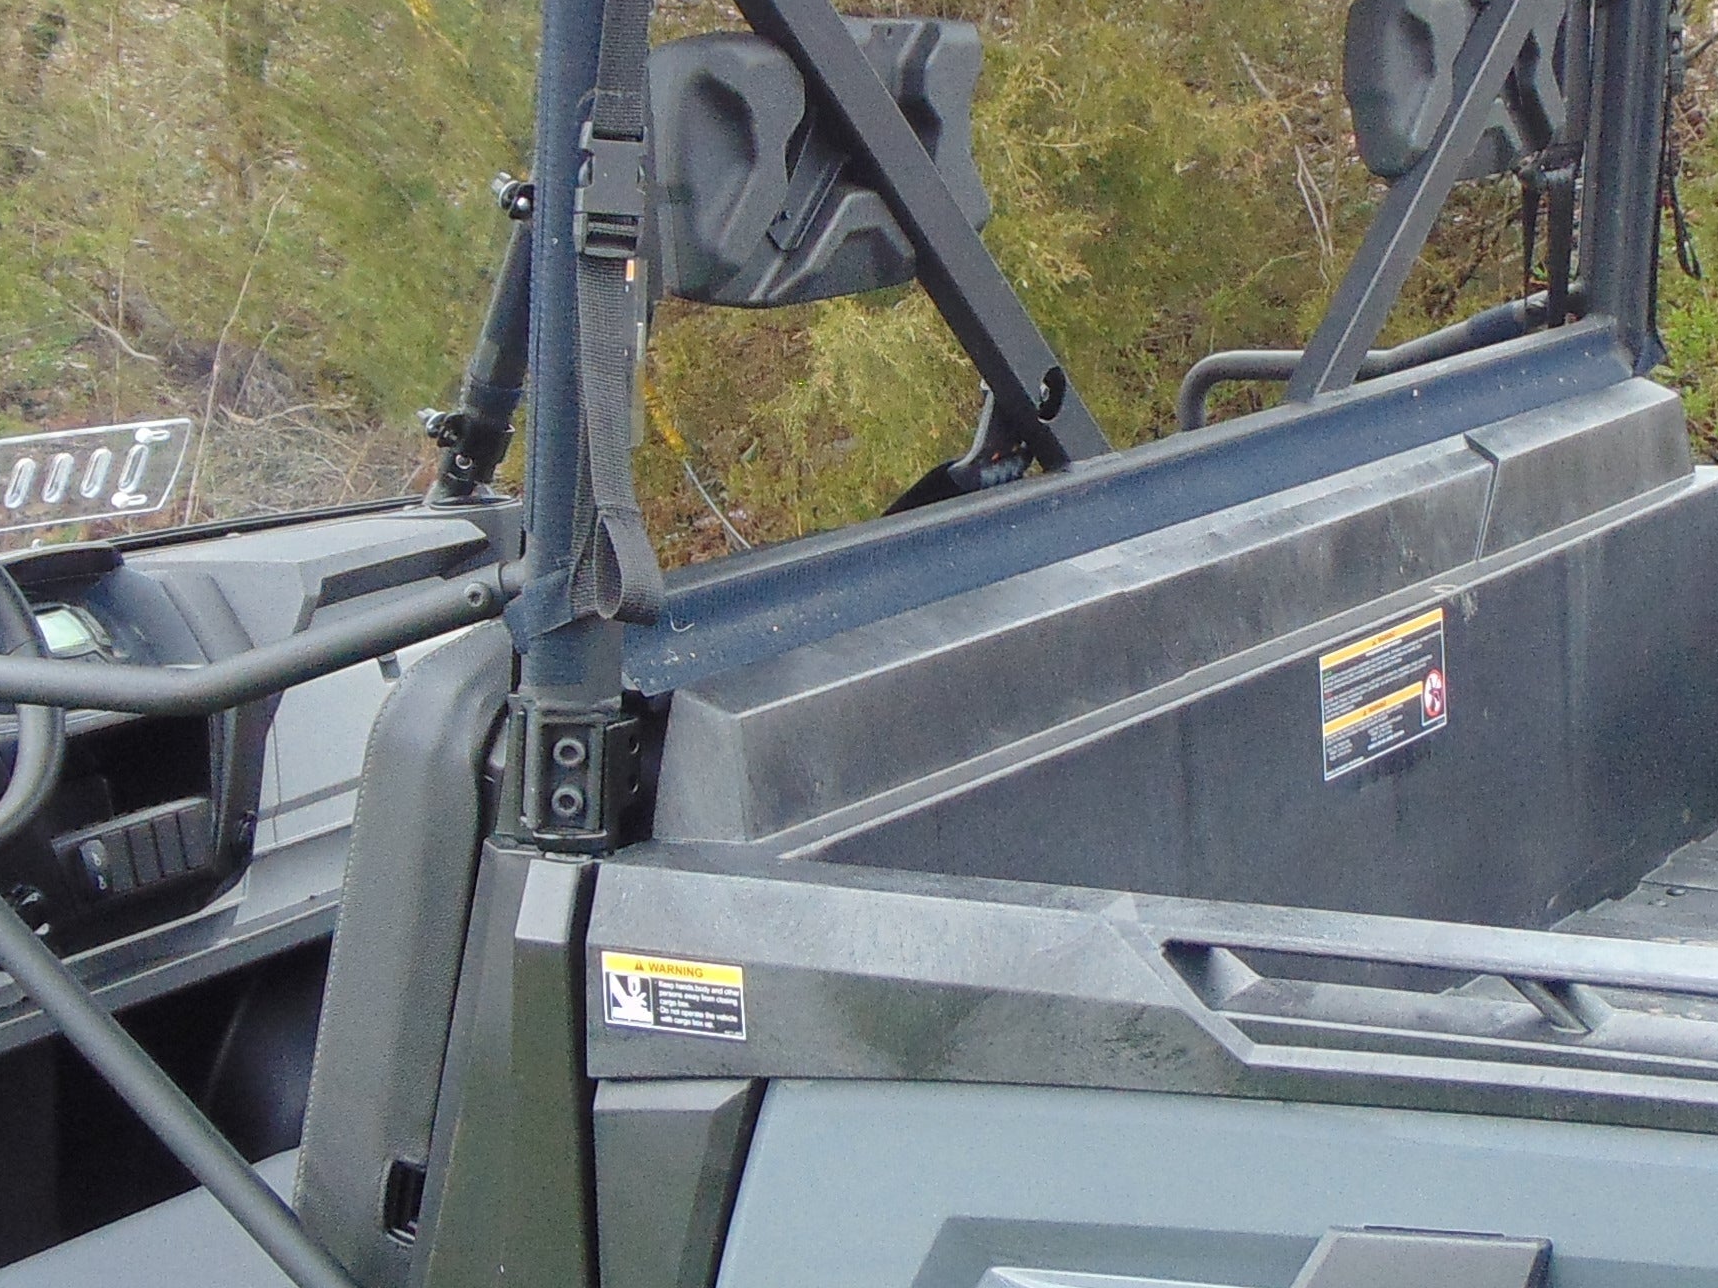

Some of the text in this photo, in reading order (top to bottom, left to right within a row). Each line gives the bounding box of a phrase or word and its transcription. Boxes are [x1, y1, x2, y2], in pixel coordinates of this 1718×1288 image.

[648, 960, 704, 978] WARNING
[658, 980, 674, 990] Keep
[711, 987, 723, 995] and
[723, 988, 740, 997] other
[658, 990, 683, 999] persons
[684, 993, 700, 1002] away
[700, 993, 716, 1002] from
[659, 998, 677, 1007] cargo
[659, 1005, 739, 1023] Do not operate the vehicle
[660, 1015, 674, 1023] with
[673, 1017, 692, 1027] cargo
[692, 1018, 704, 1027] box
